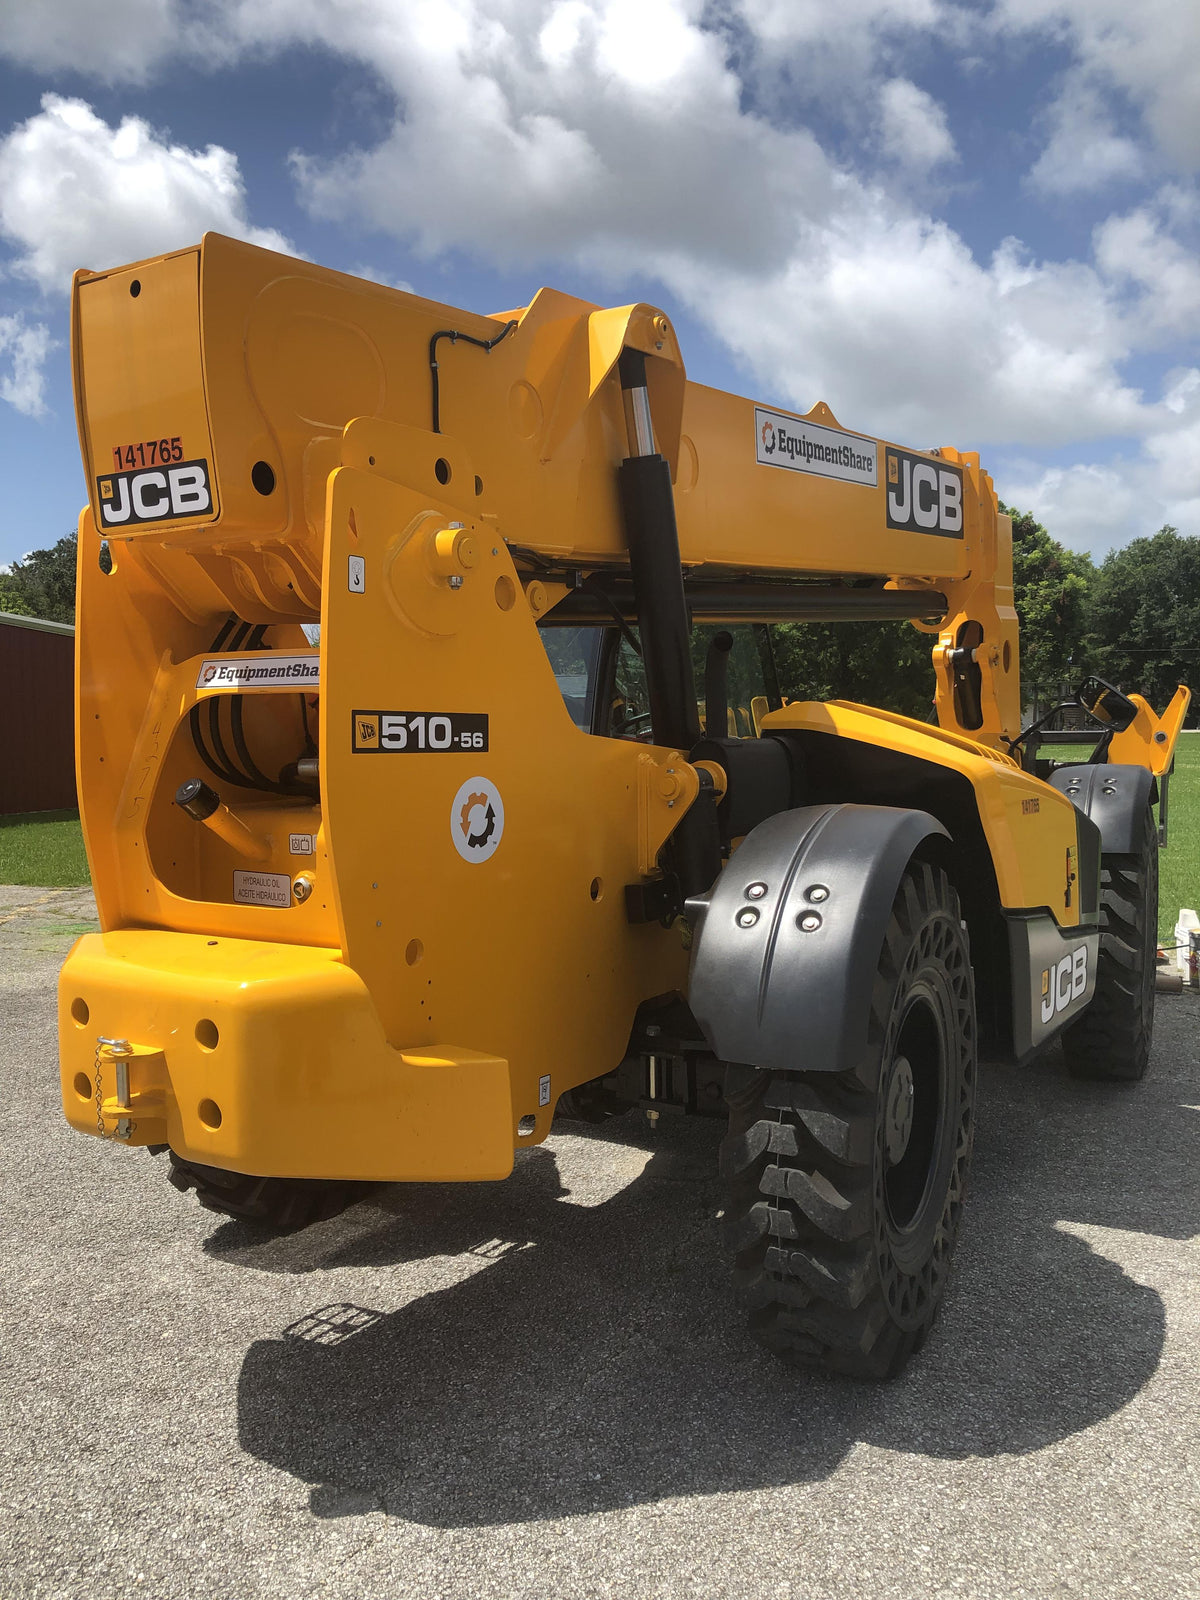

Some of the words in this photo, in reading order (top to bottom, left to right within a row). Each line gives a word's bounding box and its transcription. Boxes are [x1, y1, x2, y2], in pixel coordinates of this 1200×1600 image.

[114, 437, 184, 470] 141765
[777, 427, 873, 472] EquipmentShare
[103, 466, 209, 523] JCB
[889, 459, 963, 532] JCB
[217, 663, 320, 682] EquipmentSha
[1041, 945, 1088, 1024] JCB
